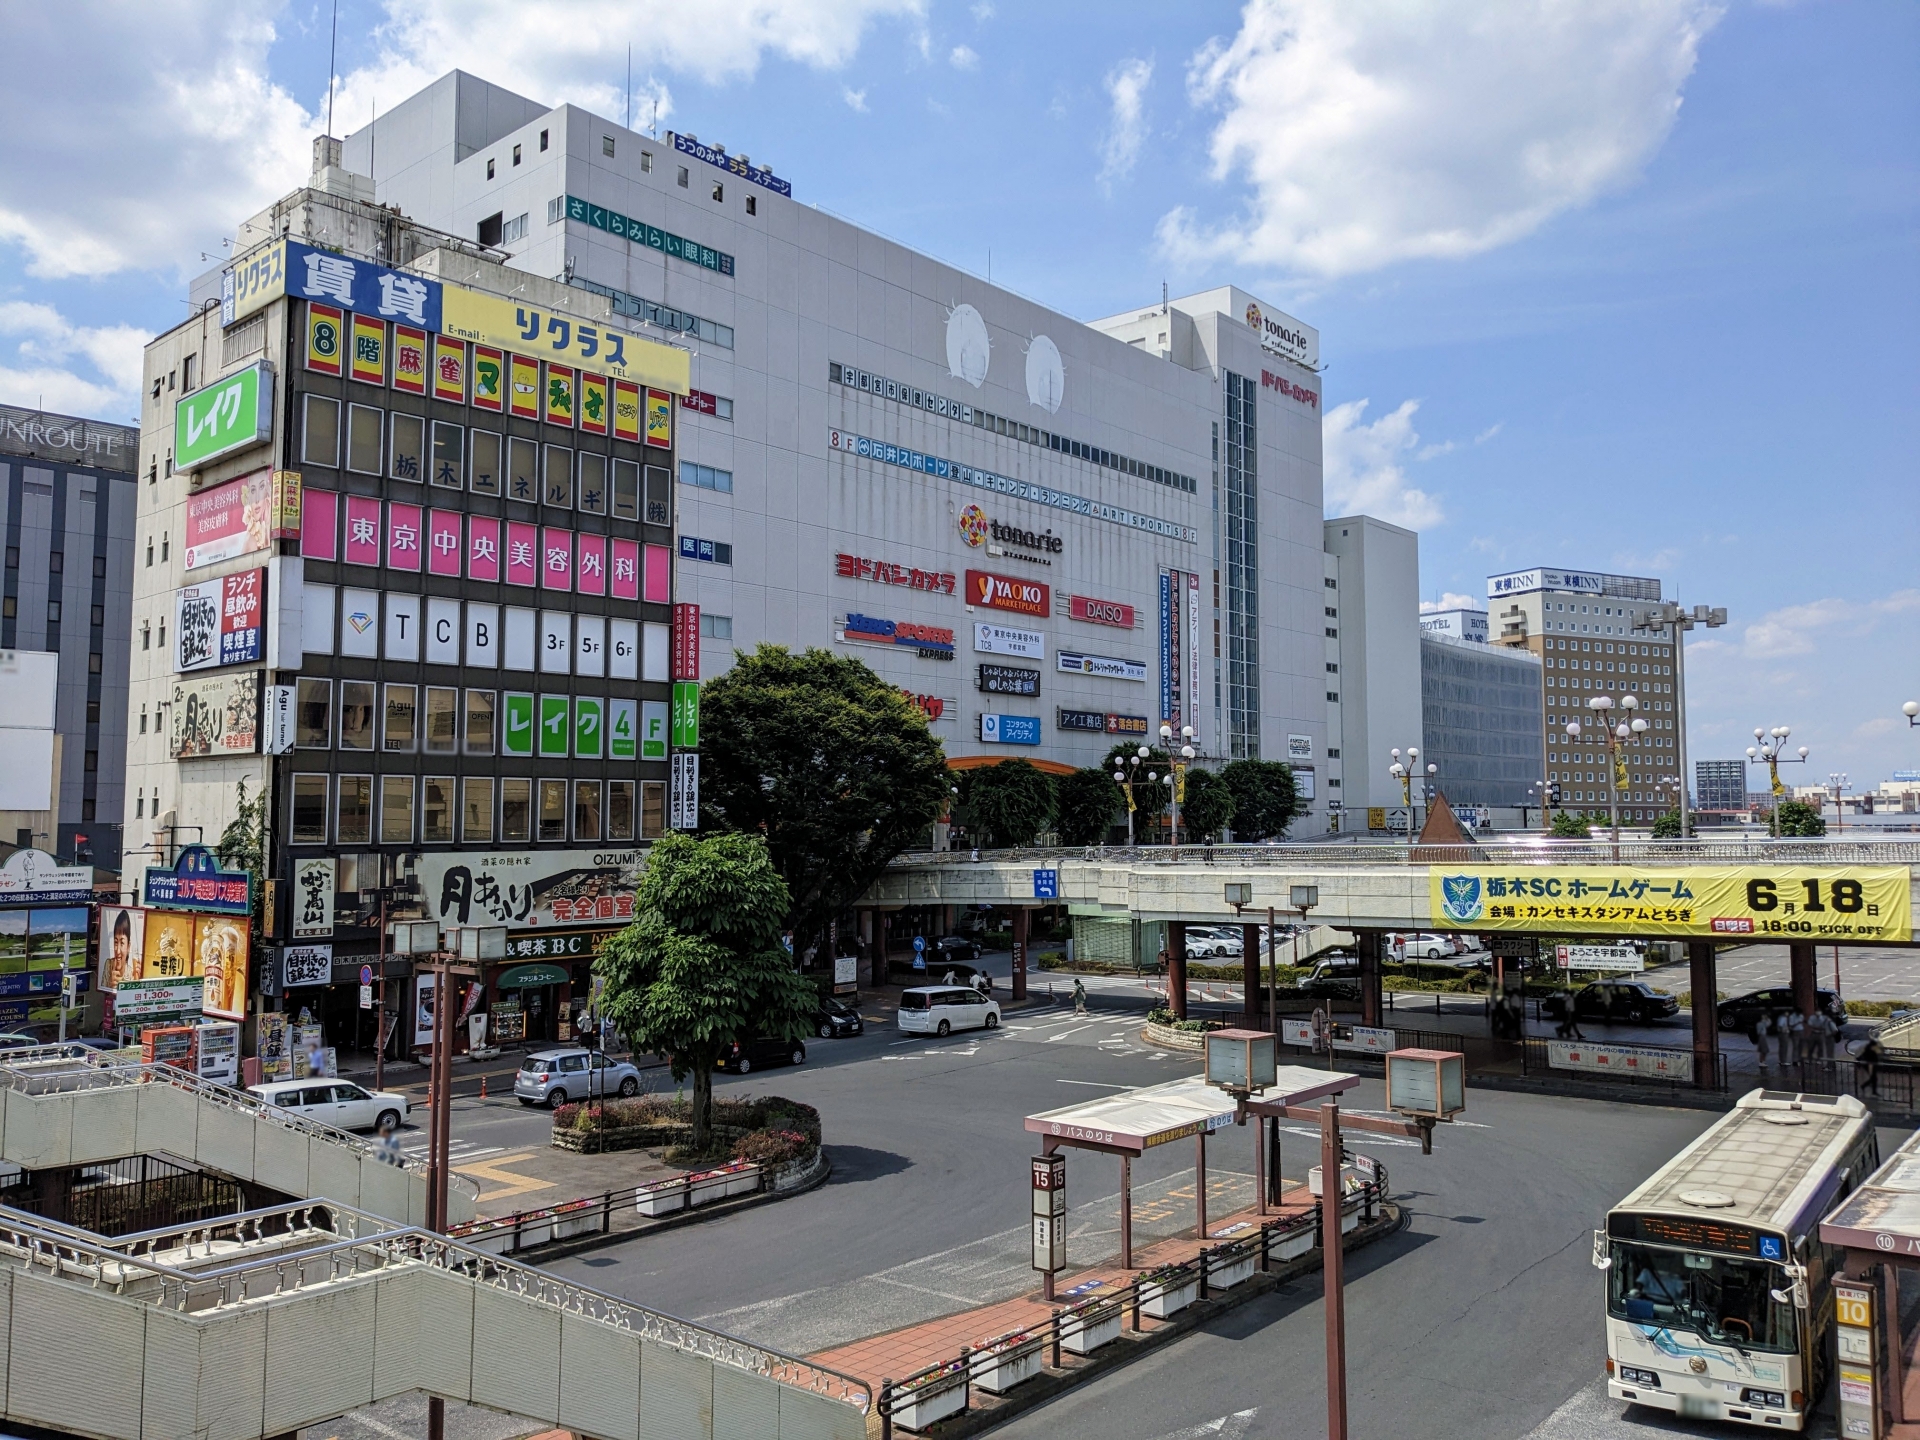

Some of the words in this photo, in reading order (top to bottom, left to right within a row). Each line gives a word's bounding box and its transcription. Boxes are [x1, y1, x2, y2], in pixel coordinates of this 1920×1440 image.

[676, 136, 726, 167] うつのみや
[570, 200, 717, 269] さくらみらい眼科
[237, 247, 283, 300] リクラス
[223, 273, 235, 325] 賃貸
[302, 252, 428, 326] 賃貸
[515, 307, 628, 368] リクラス
[1264, 315, 1307, 350] tonarie
[844, 367, 972, 423] 宇都宮市保健センター
[1261, 368, 1318, 408] ヨドバシカメラ
[187, 382, 243, 449] レイク
[871, 441, 948, 476] 石井スポーツ
[189, 488, 239, 518] 東京中央美容外科
[1102, 506, 1126, 523] ART
[683, 538, 712, 555] 医院
[991, 519, 1063, 554] tonarie
[350, 516, 636, 584] 東京中央美容外科
[227, 571, 256, 597] ランチ
[838, 553, 956, 594] ヨドバシカメラ
[1494, 573, 1534, 592] 東横INN
[1563, 574, 1599, 590] 東横INN
[995, 580, 1041, 603] YAOKO
[225, 593, 257, 617] 昼飲み
[995, 598, 1042, 613] MARKETPLACE
[1087, 601, 1123, 622] DAISO
[396, 613, 490, 648] TCB
[895, 622, 953, 645] SPORTS
[1420, 619, 1450, 630] HOTEL
[223, 629, 256, 651] 喫煙室
[675, 606, 683, 677] 東京中央美容外科
[688, 606, 697, 678] 東京中央美容外科
[980, 640, 992, 651] TCB
[994, 629, 1040, 644] 東京中央美容外科
[222, 650, 247, 663] あります
[918, 647, 954, 661] EXPRESS
[983, 665, 1039, 681] しゃぶしゃぶバイキング
[279, 689, 288, 711] Agu
[388, 700, 411, 711] Agu
[902, 690, 944, 721] リヤ
[510, 709, 599, 736] レイク
[686, 699, 695, 728] レイク
[1006, 720, 1034, 730] コンタクトの
[1063, 713, 1102, 730] アイ工務店
[1108, 716, 1117, 730] 本
[1118, 717, 1147, 732] 落合書店
[1006, 729, 1033, 740] アイシティ
[480, 857, 532, 867] 酒菜の隠れ家
[300, 870, 332, 925] 妙高山
[440, 865, 533, 925] 月あかり
[553, 885, 590, 897] 2名様より
[1487, 876, 1562, 898] 栃木SC
[1567, 877, 1695, 901] ホームゲーム
[552, 895, 636, 923] 完全個室
[1761, 919, 1813, 933] 18:00
[1818, 925, 1854, 935] KICK
[1857, 925, 1884, 936] OFF
[153, 956, 184, 977] 一番搾り
[518, 973, 556, 983] ブラジルコーヒー
[1066, 1126, 1114, 1143] バスのりば
[1034, 1171, 1048, 1187] 15
[1053, 1170, 1064, 1187] 15
[1838, 1289, 1867, 1300] 関東バス
[1840, 1300, 1866, 1323] 10
